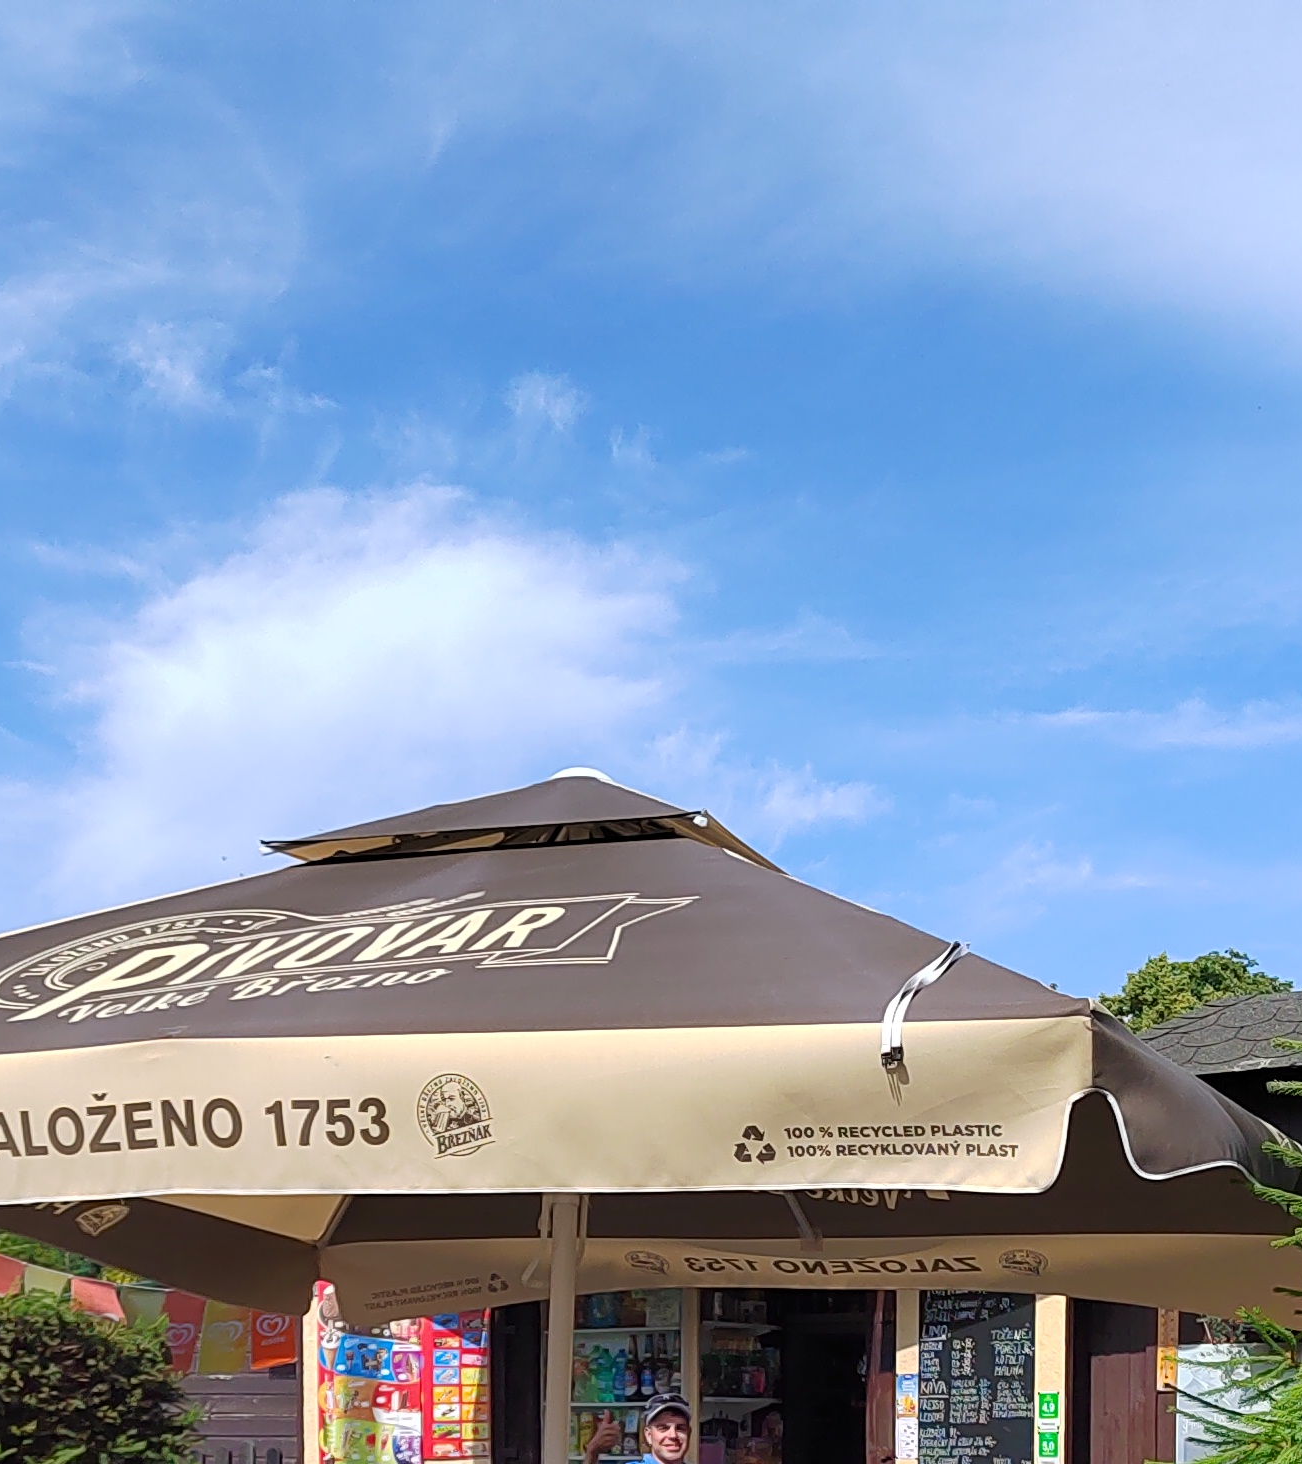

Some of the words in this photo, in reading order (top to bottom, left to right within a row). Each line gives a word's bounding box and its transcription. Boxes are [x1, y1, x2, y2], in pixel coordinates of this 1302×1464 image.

[6, 906, 566, 1022] PIVOVAR
[57, 985, 219, 1024] Velké
[228, 967, 454, 1002] Březno
[264, 1097, 391, 1148] 1753
[784, 1125, 815, 1140] 100
[818, 1125, 834, 1139] %
[837, 1124, 926, 1139] RECYCLED
[930, 1123, 1004, 1138] PLASTIC
[786, 1143, 832, 1158] 100%
[835, 1139, 962, 1157] RECYKLOVANÝ
[966, 1143, 1019, 1158] PLAST
